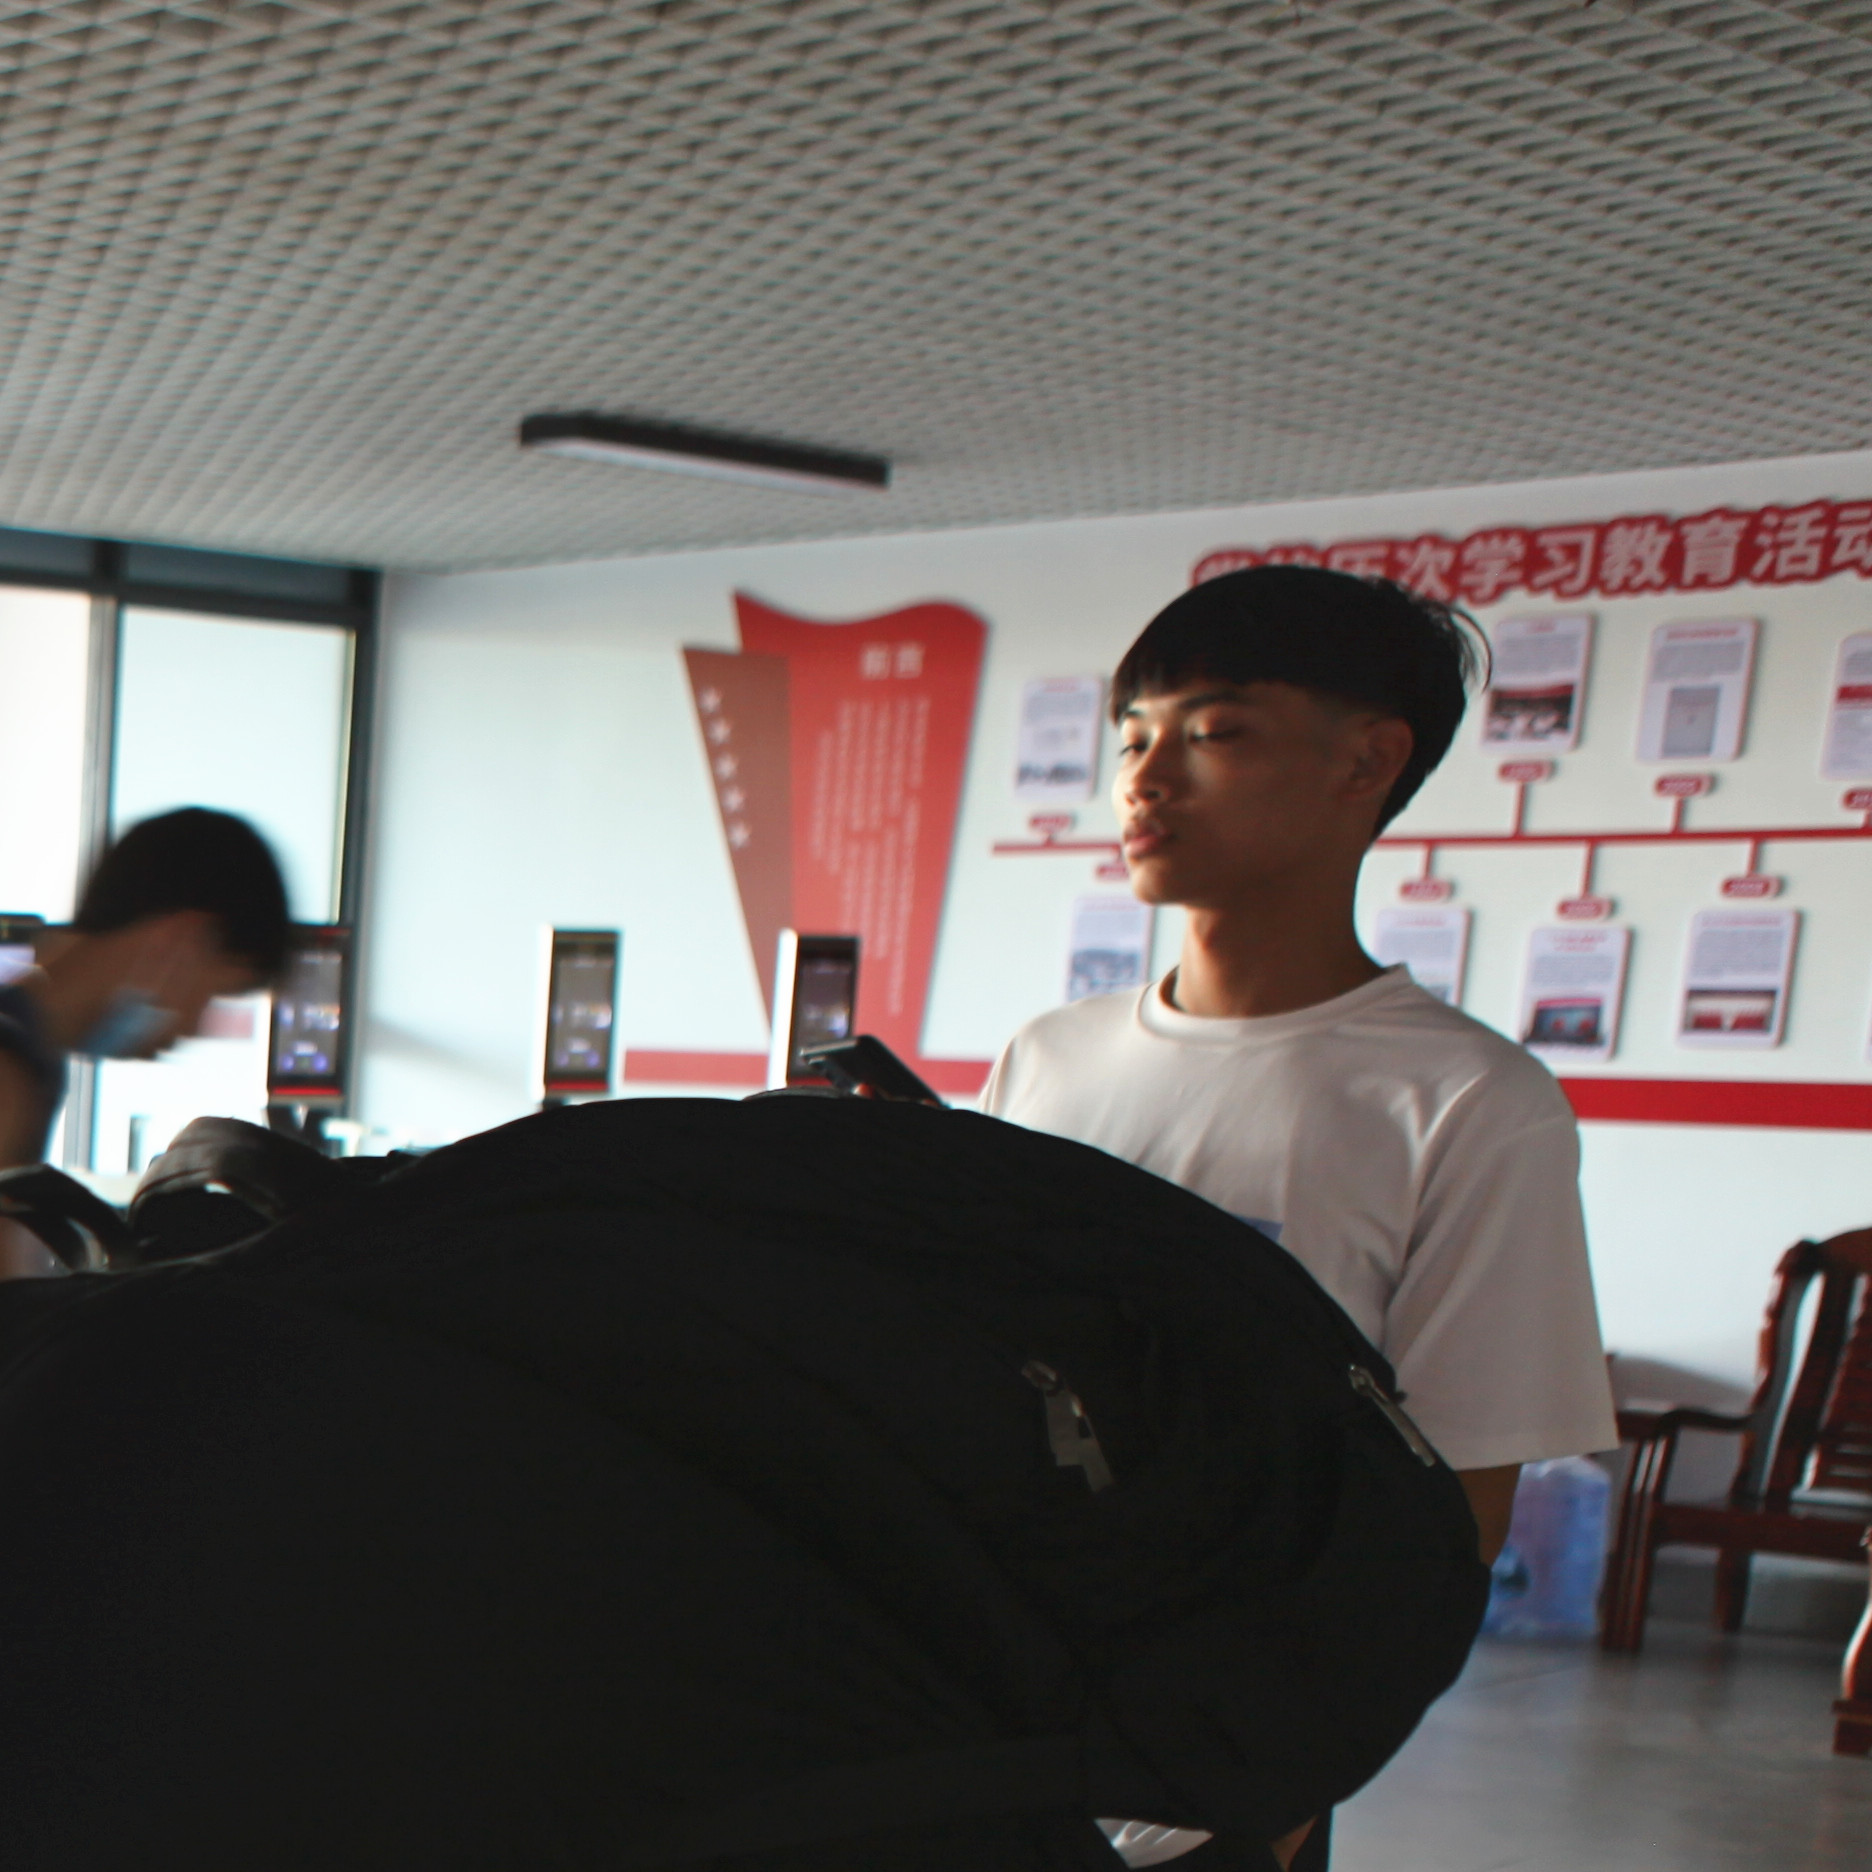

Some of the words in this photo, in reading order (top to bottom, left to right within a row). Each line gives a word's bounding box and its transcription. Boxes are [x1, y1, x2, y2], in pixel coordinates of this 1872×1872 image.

[1195, 505, 1872, 600] 次学习教育活动
